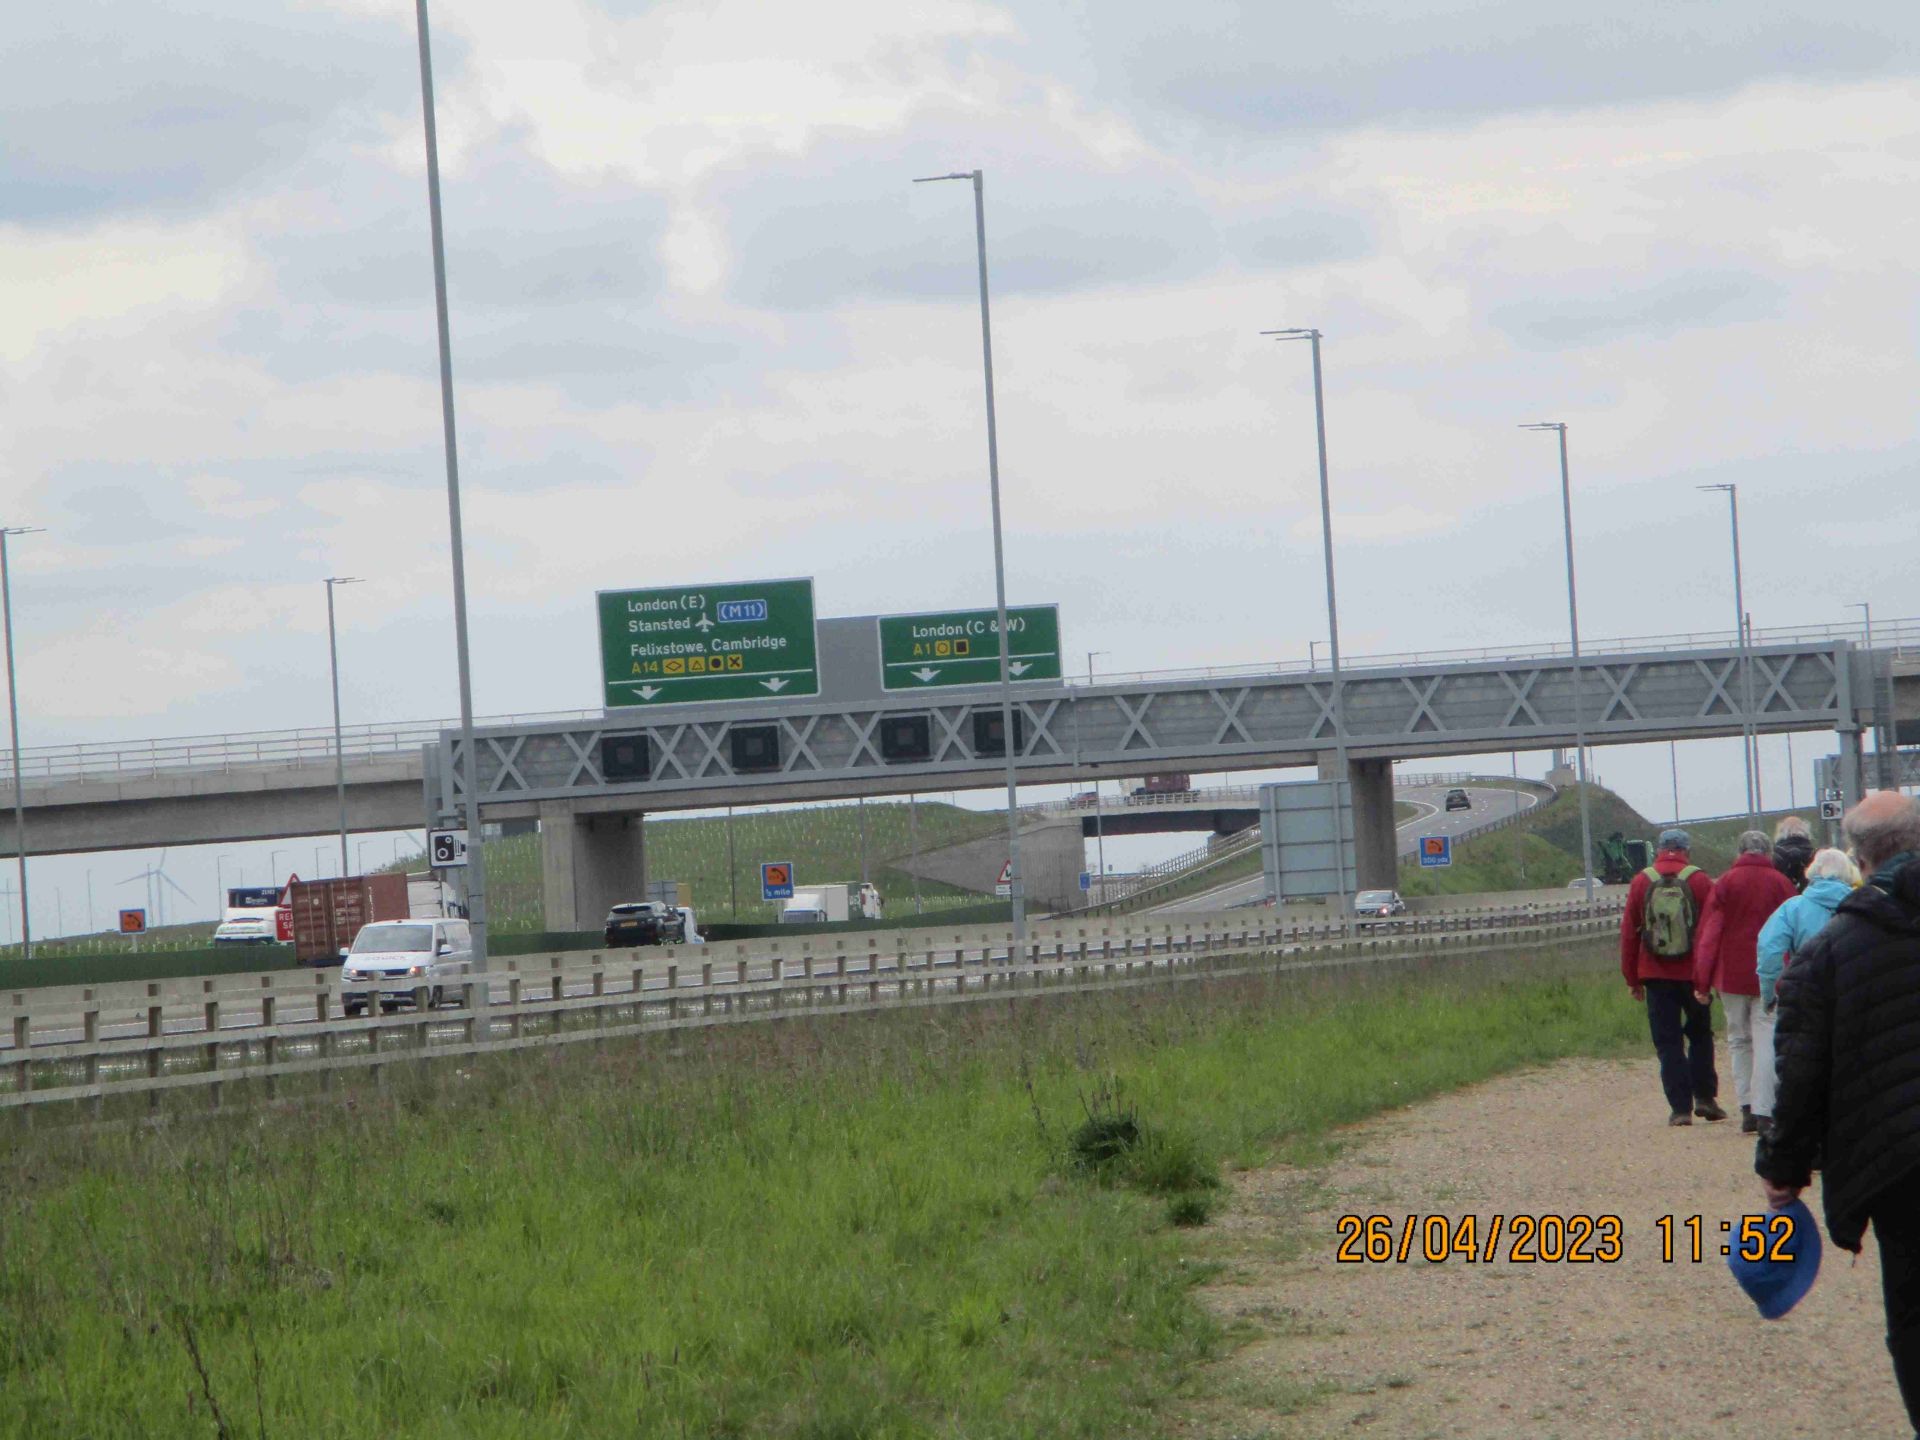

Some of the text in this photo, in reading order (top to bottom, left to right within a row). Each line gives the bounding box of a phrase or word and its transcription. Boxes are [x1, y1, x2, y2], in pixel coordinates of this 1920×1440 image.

[627, 594, 706, 613] London (E)
[628, 616, 691, 633] Stansted
[912, 623, 963, 638] London
[966, 620, 985, 635] (C
[711, 635, 787, 652] Cambridge
[912, 642, 931, 656] A1
[631, 660, 658, 674] A14
